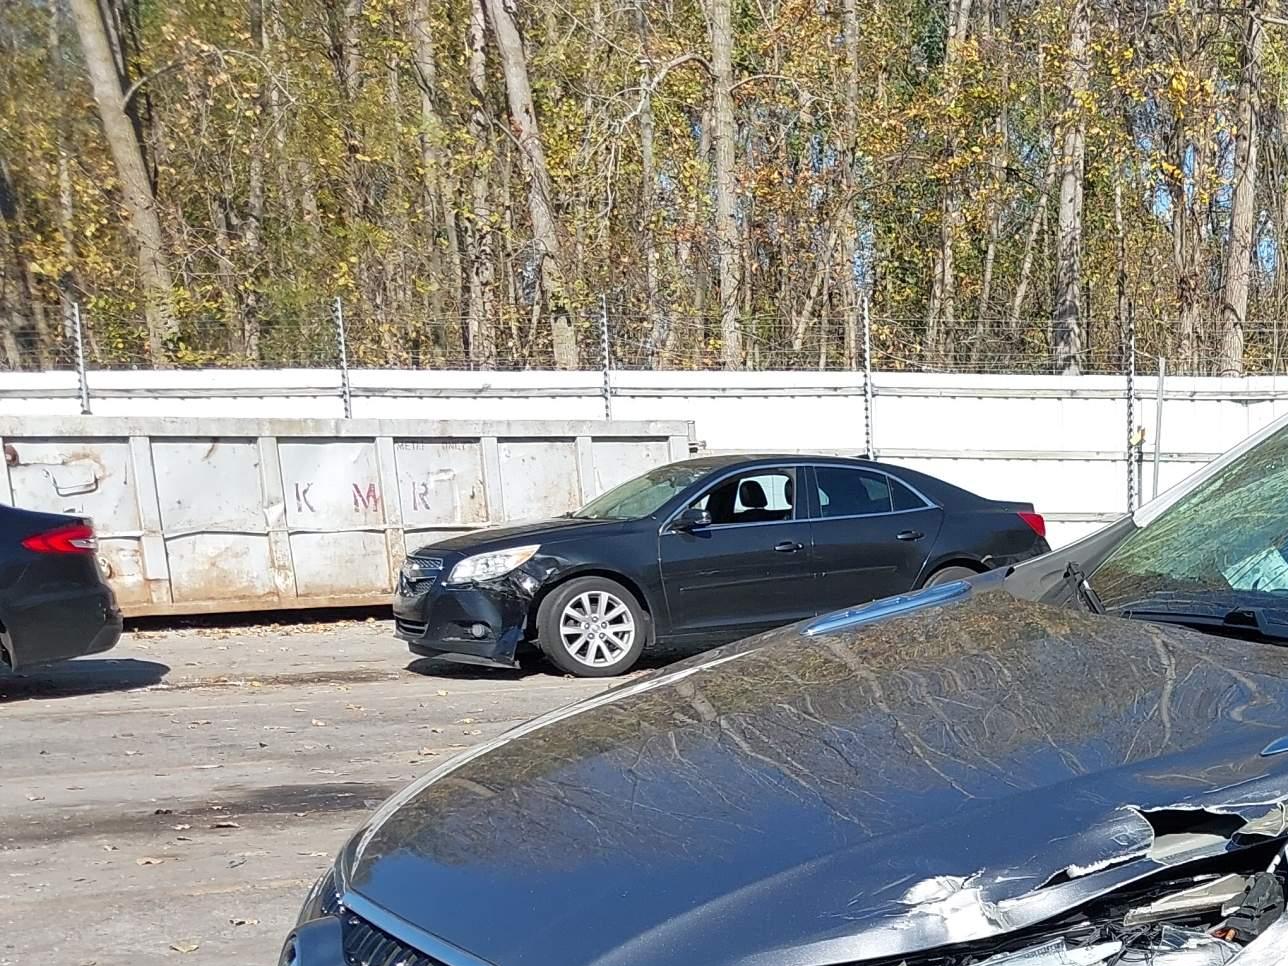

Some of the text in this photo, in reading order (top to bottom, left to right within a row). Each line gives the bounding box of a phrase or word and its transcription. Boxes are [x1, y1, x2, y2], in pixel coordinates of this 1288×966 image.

[295, 480, 431, 513] K M R
